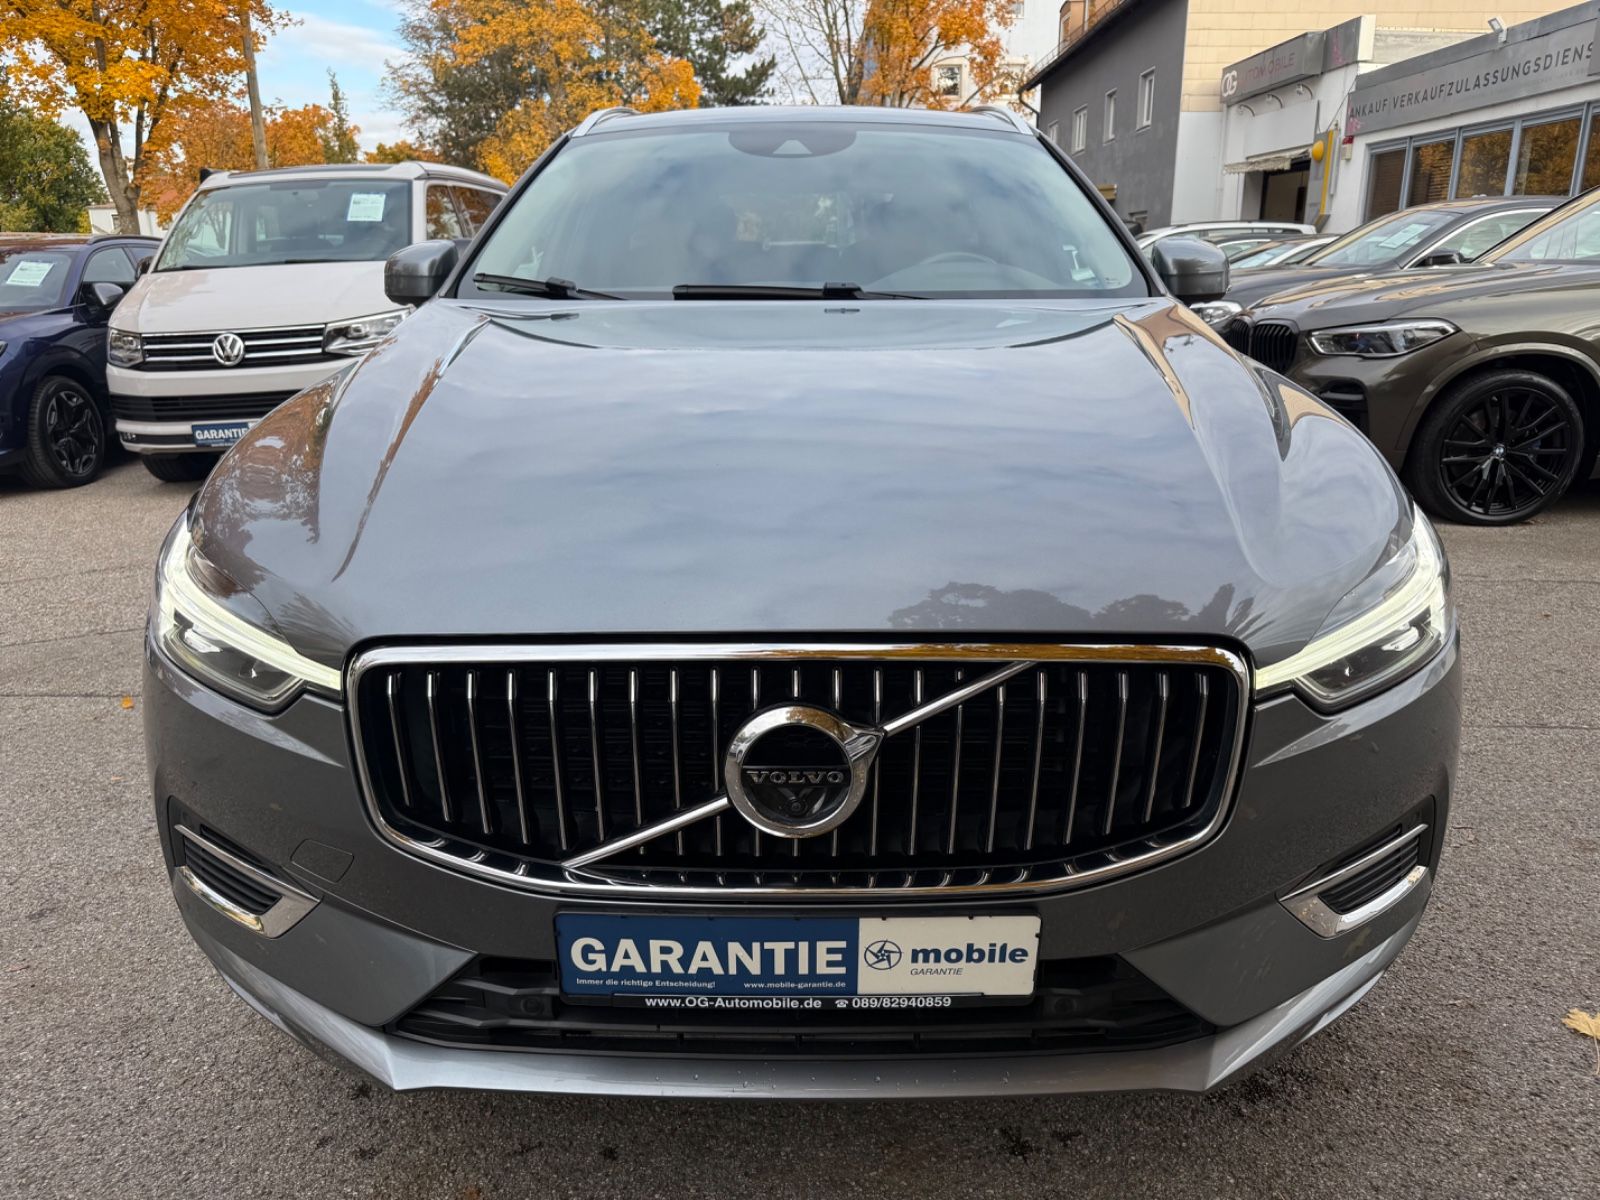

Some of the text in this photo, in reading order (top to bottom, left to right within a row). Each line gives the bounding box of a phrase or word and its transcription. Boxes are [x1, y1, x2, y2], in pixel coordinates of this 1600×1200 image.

[1221, 70, 1238, 97] OG
[1349, 98, 1388, 118] ANKAUF
[746, 771, 844, 784] VOLVO
[570, 937, 847, 975] GARANTIE
[911, 943, 1029, 964] mobile
[910, 968, 964, 976] GARANTIE
[605, 978, 619, 986] die
[621, 979, 653, 988] richtige
[655, 980, 716, 989] Entscheidung!
[743, 981, 847, 989] www.mobile-garantie.de
[645, 997, 952, 1009] www.OG-Automobile.de 089/82940859
